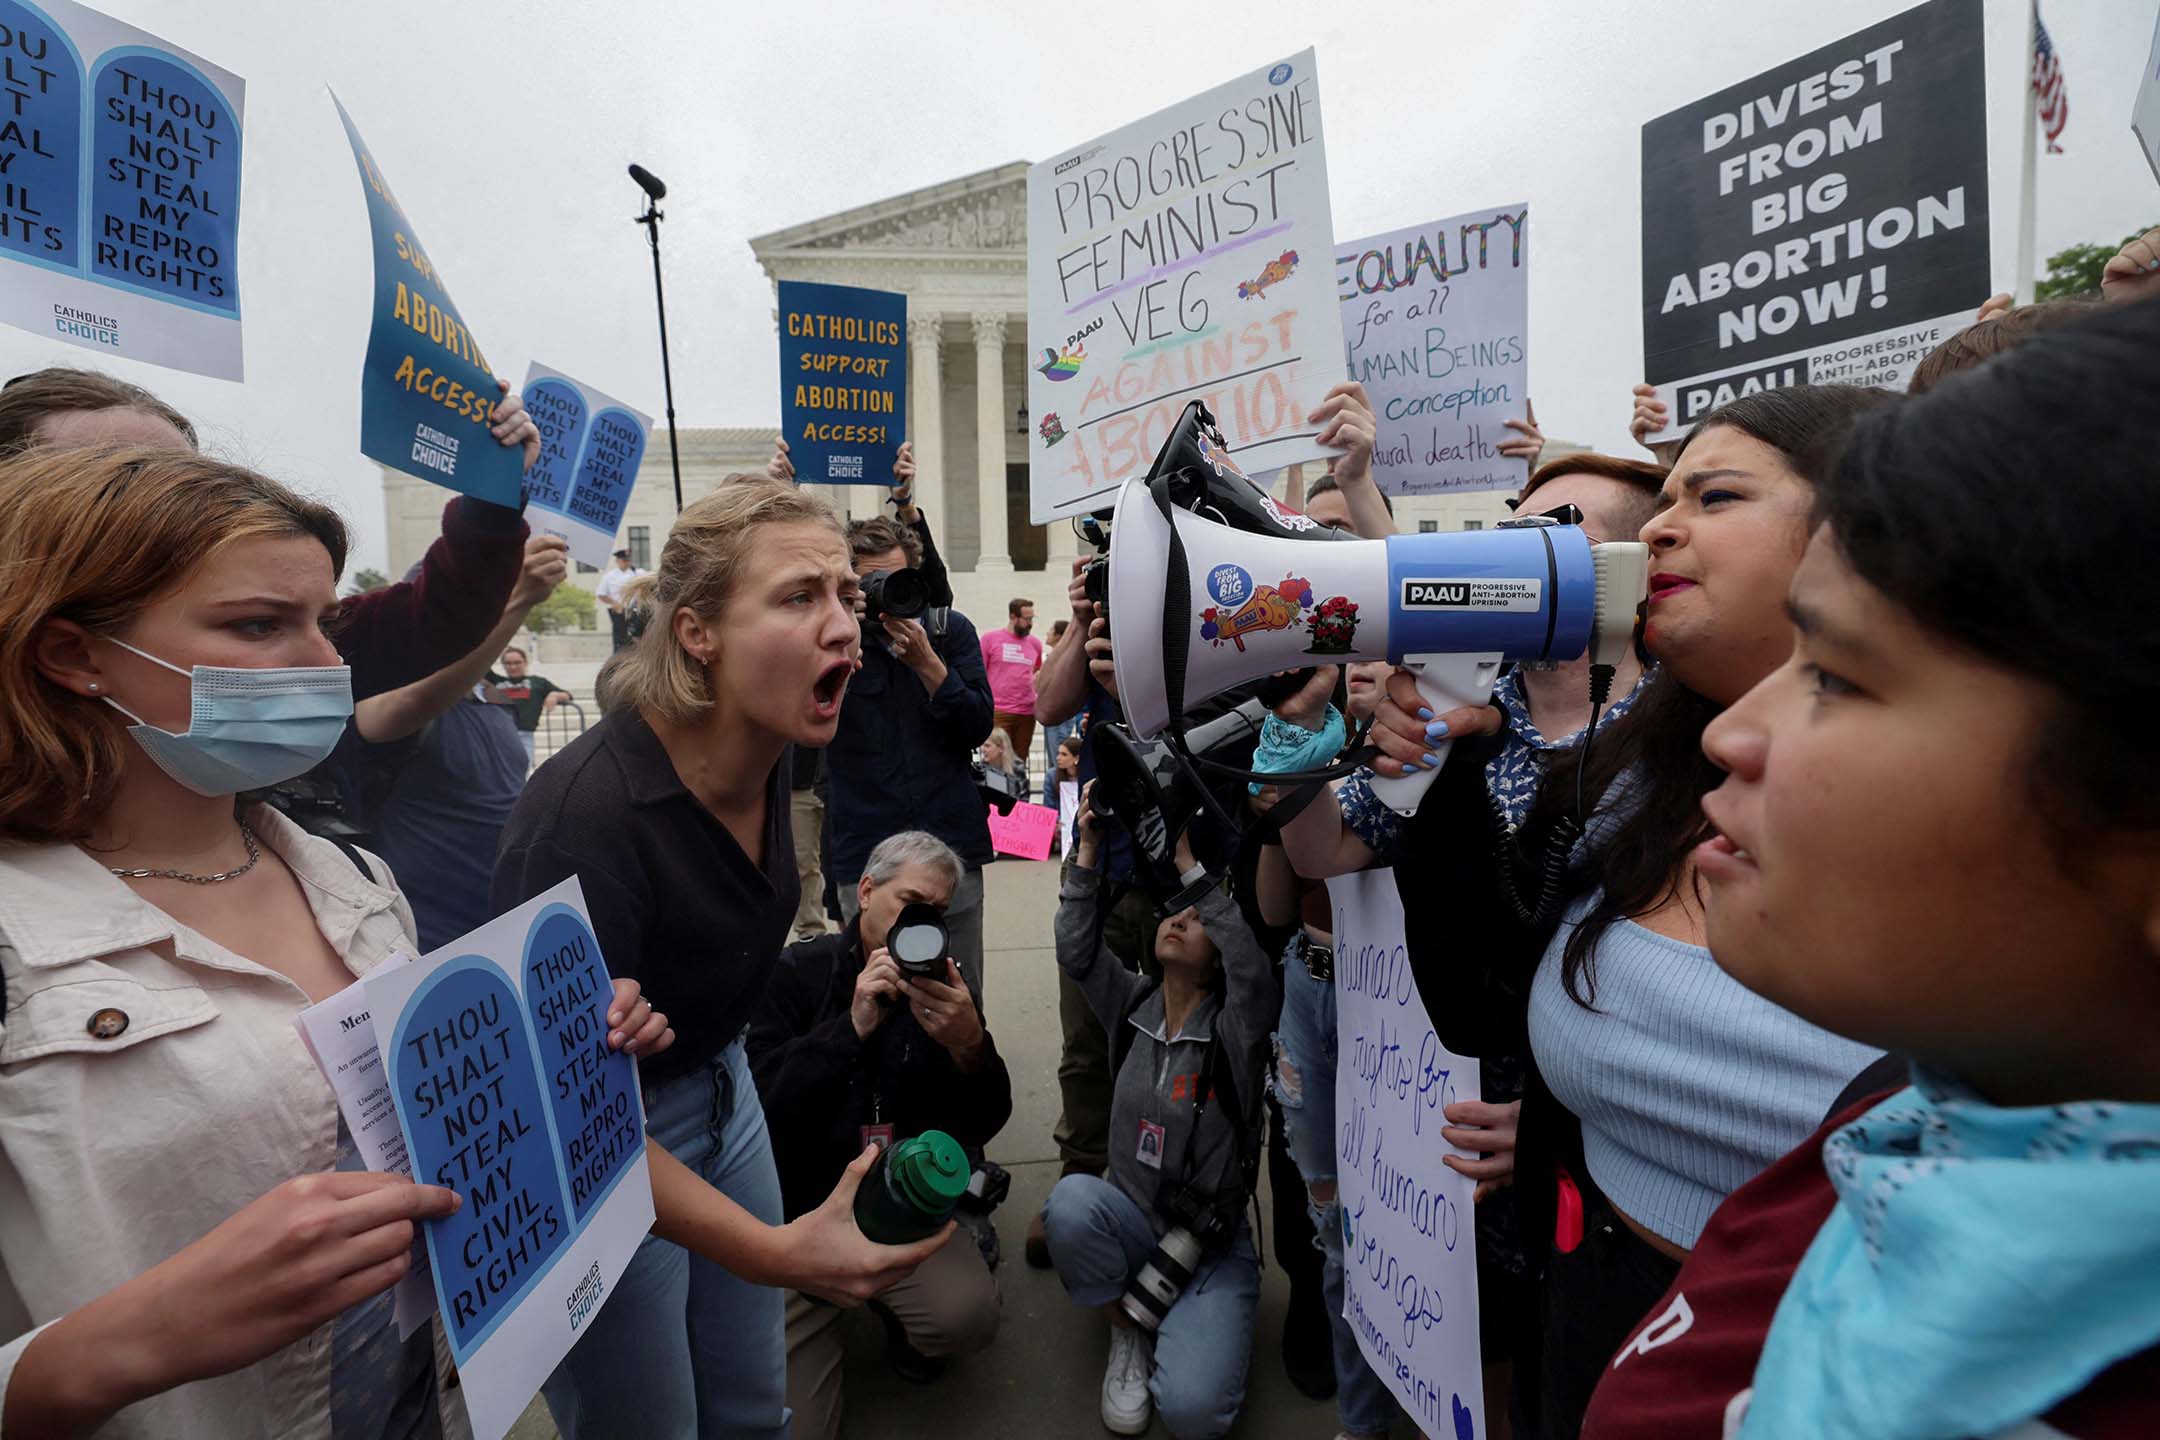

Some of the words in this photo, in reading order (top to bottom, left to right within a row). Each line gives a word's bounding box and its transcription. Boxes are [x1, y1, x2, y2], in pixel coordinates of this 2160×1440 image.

[114, 68, 215, 129] THOU
[1704, 39, 1903, 153] DIVEST
[107, 97, 221, 159] SHALT
[1719, 102, 1883, 196] FROM
[129, 134, 202, 180] NOT
[1055, 77, 1313, 234] PROGRESSIVE
[108, 157, 219, 216] STEAL
[139, 196, 190, 231] MY
[1751, 172, 1848, 236] BIG
[104, 214, 219, 268] REPRO
[1057, 160, 1296, 302] FEMINIST
[1336, 209, 1528, 301] EQUALITY
[1660, 186, 1965, 314] ABORTION
[98, 242, 225, 297] RIGHTS
[54, 303, 118, 329] CATHOLICS
[55, 318, 119, 346] CHOICE
[788, 312, 899, 345] CATHOLICS
[1066, 317, 1103, 347] PAAU
[1112, 271, 1208, 346] VEG
[1353, 300, 1393, 351] for
[1406, 285, 1450, 320] all
[1719, 265, 1888, 349] NOW!
[800, 352, 889, 378] SUPPORT
[1080, 310, 1298, 415] AGAINST
[1425, 328, 1523, 378] BEINGS
[1812, 328, 1940, 367] PROGRESSIVE
[395, 354, 498, 428] ACCESS!
[526, 402, 578, 431] SHALT
[535, 388, 579, 417] THOU
[794, 384, 894, 413] ABORTION
[1385, 378, 1511, 421] conception
[411, 442, 457, 475] CHOICE
[416, 422, 460, 453] CATHOLICS
[592, 431, 636, 459] SHALT
[595, 447, 625, 466] NOT
[600, 418, 638, 445] THOU
[803, 421, 887, 444] ACCESS!
[1425, 424, 1496, 467] death
[585, 458, 625, 486] STEAL
[591, 475, 614, 493] MY
[828, 455, 863, 465] CATHOLICS
[828, 466, 863, 478] CHOICE
[570, 499, 617, 527] RIGHTS
[576, 485, 618, 512] REPRO
[1216, 572, 1240, 586] FROM
[1219, 580, 1242, 598] BIG
[1411, 586, 1464, 602] PAAU
[1472, 583, 1526, 591] PROGRESSIVE
[531, 935, 586, 991] THOU
[1337, 906, 1413, 1006] human
[538, 964, 598, 1032] SHALT
[408, 993, 500, 1069] THOU
[559, 1003, 599, 1057] NOT
[337, 1061, 349, 1073] An
[414, 1027, 511, 1119] SHALT
[1353, 1018, 1413, 1109] rights
[1414, 1030, 1455, 1136] for
[444, 1075, 503, 1147] NOT
[580, 1071, 606, 1119] MY
[436, 1108, 531, 1190] STEAL
[568, 1090, 628, 1171] REPRO
[470, 1156, 513, 1218] MY
[572, 1116, 636, 1207] RIGHTS
[1341, 1105, 1364, 1176] all
[1371, 1127, 1458, 1251] human
[463, 1188, 540, 1269] CIVIL
[453, 1206, 559, 1329] RIGHTS
[566, 1260, 600, 1311] CATHOLICS
[1354, 1195, 1444, 1349] beings
[570, 1275, 604, 1331] CHOICE
